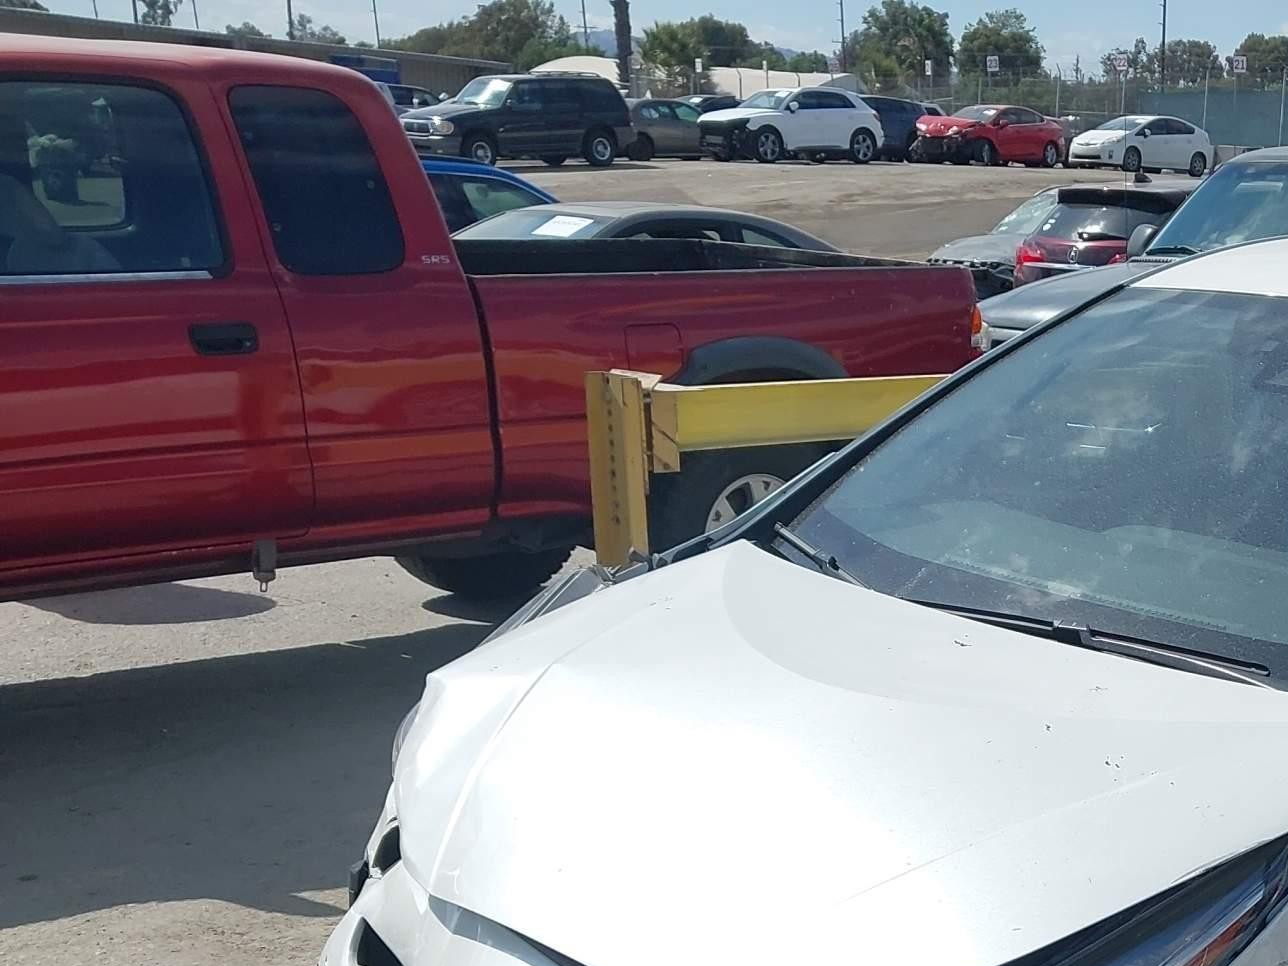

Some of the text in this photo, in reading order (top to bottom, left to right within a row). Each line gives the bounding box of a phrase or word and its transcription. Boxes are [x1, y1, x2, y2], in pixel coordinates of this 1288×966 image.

[986, 58, 999, 69] 23
[1116, 56, 1128, 67] 22
[1233, 59, 1246, 70] 21
